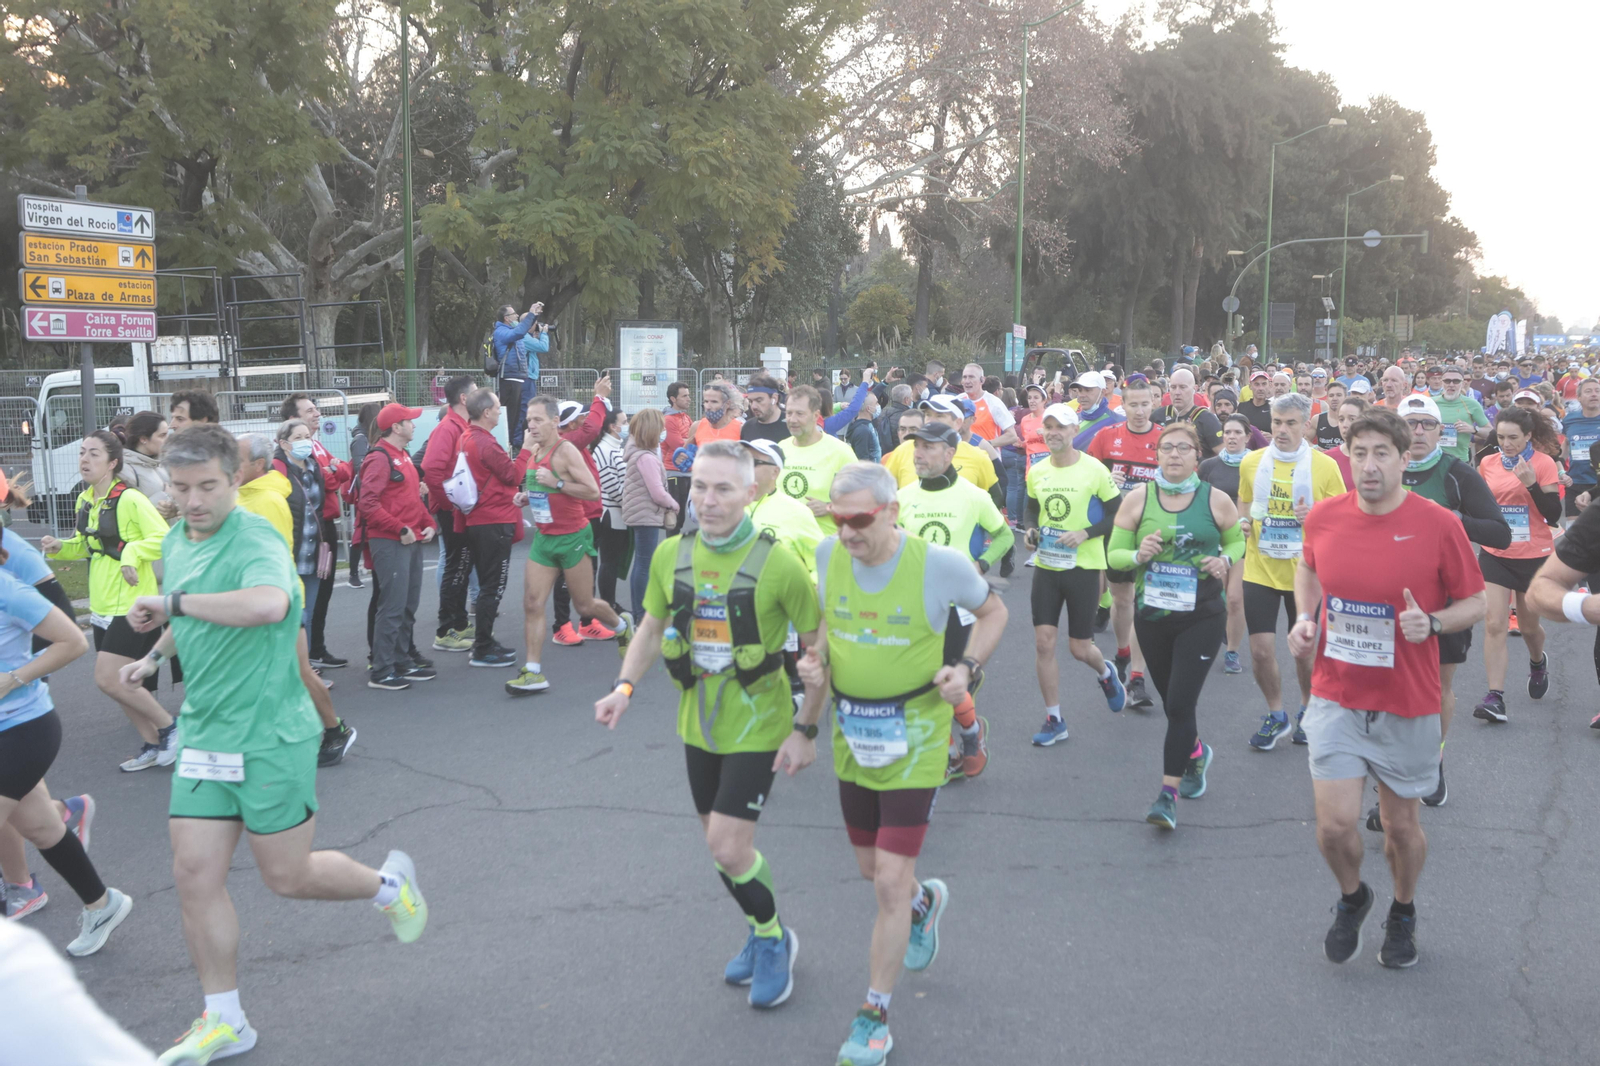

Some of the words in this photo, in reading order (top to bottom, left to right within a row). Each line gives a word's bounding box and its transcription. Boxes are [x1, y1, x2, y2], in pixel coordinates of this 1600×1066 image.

[26, 200, 62, 212] hospital
[27, 212, 62, 226] Virgen
[66, 216, 84, 228] del
[28, 240, 65, 251] estación
[70, 241, 98, 254] Prado
[28, 251, 50, 262] San
[55, 253, 107, 266] Sebastián
[118, 280, 152, 290] estación
[67, 289, 95, 300] Plaza
[101, 291, 114, 302] de
[120, 292, 152, 303] Armas
[86, 313, 116, 325] Caixa
[121, 314, 152, 326] Forum
[84, 326, 112, 337] Torre
[118, 326, 152, 338] Sevilla
[116, 408, 132, 416] AMS
[270, 406, 282, 414] AM
[1160, 565, 1192, 576] ZURICH
[1344, 602, 1386, 616] ZURICH
[1345, 622, 1369, 635] 9184
[1334, 635, 1356, 648] JAIME
[1357, 642, 1383, 651] LOPEZ
[853, 704, 896, 718] ZURICH
[852, 741, 886, 753] SANDRO
